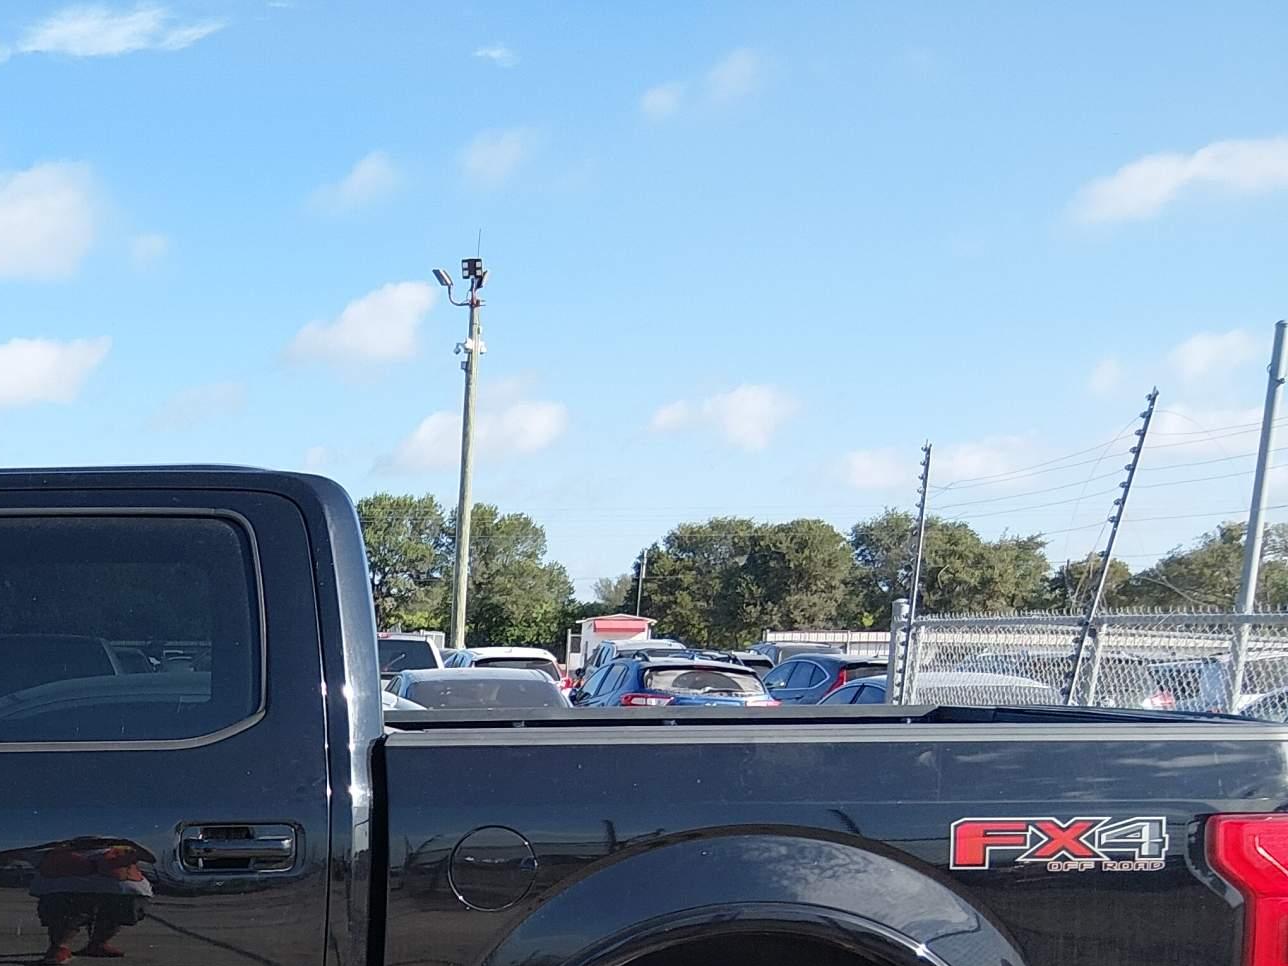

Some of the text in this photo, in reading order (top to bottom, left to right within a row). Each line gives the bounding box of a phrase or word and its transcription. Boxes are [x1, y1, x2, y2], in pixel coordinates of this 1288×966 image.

[950, 817, 1169, 870] FX4
[1047, 860, 1165, 871] OFF ROAD
